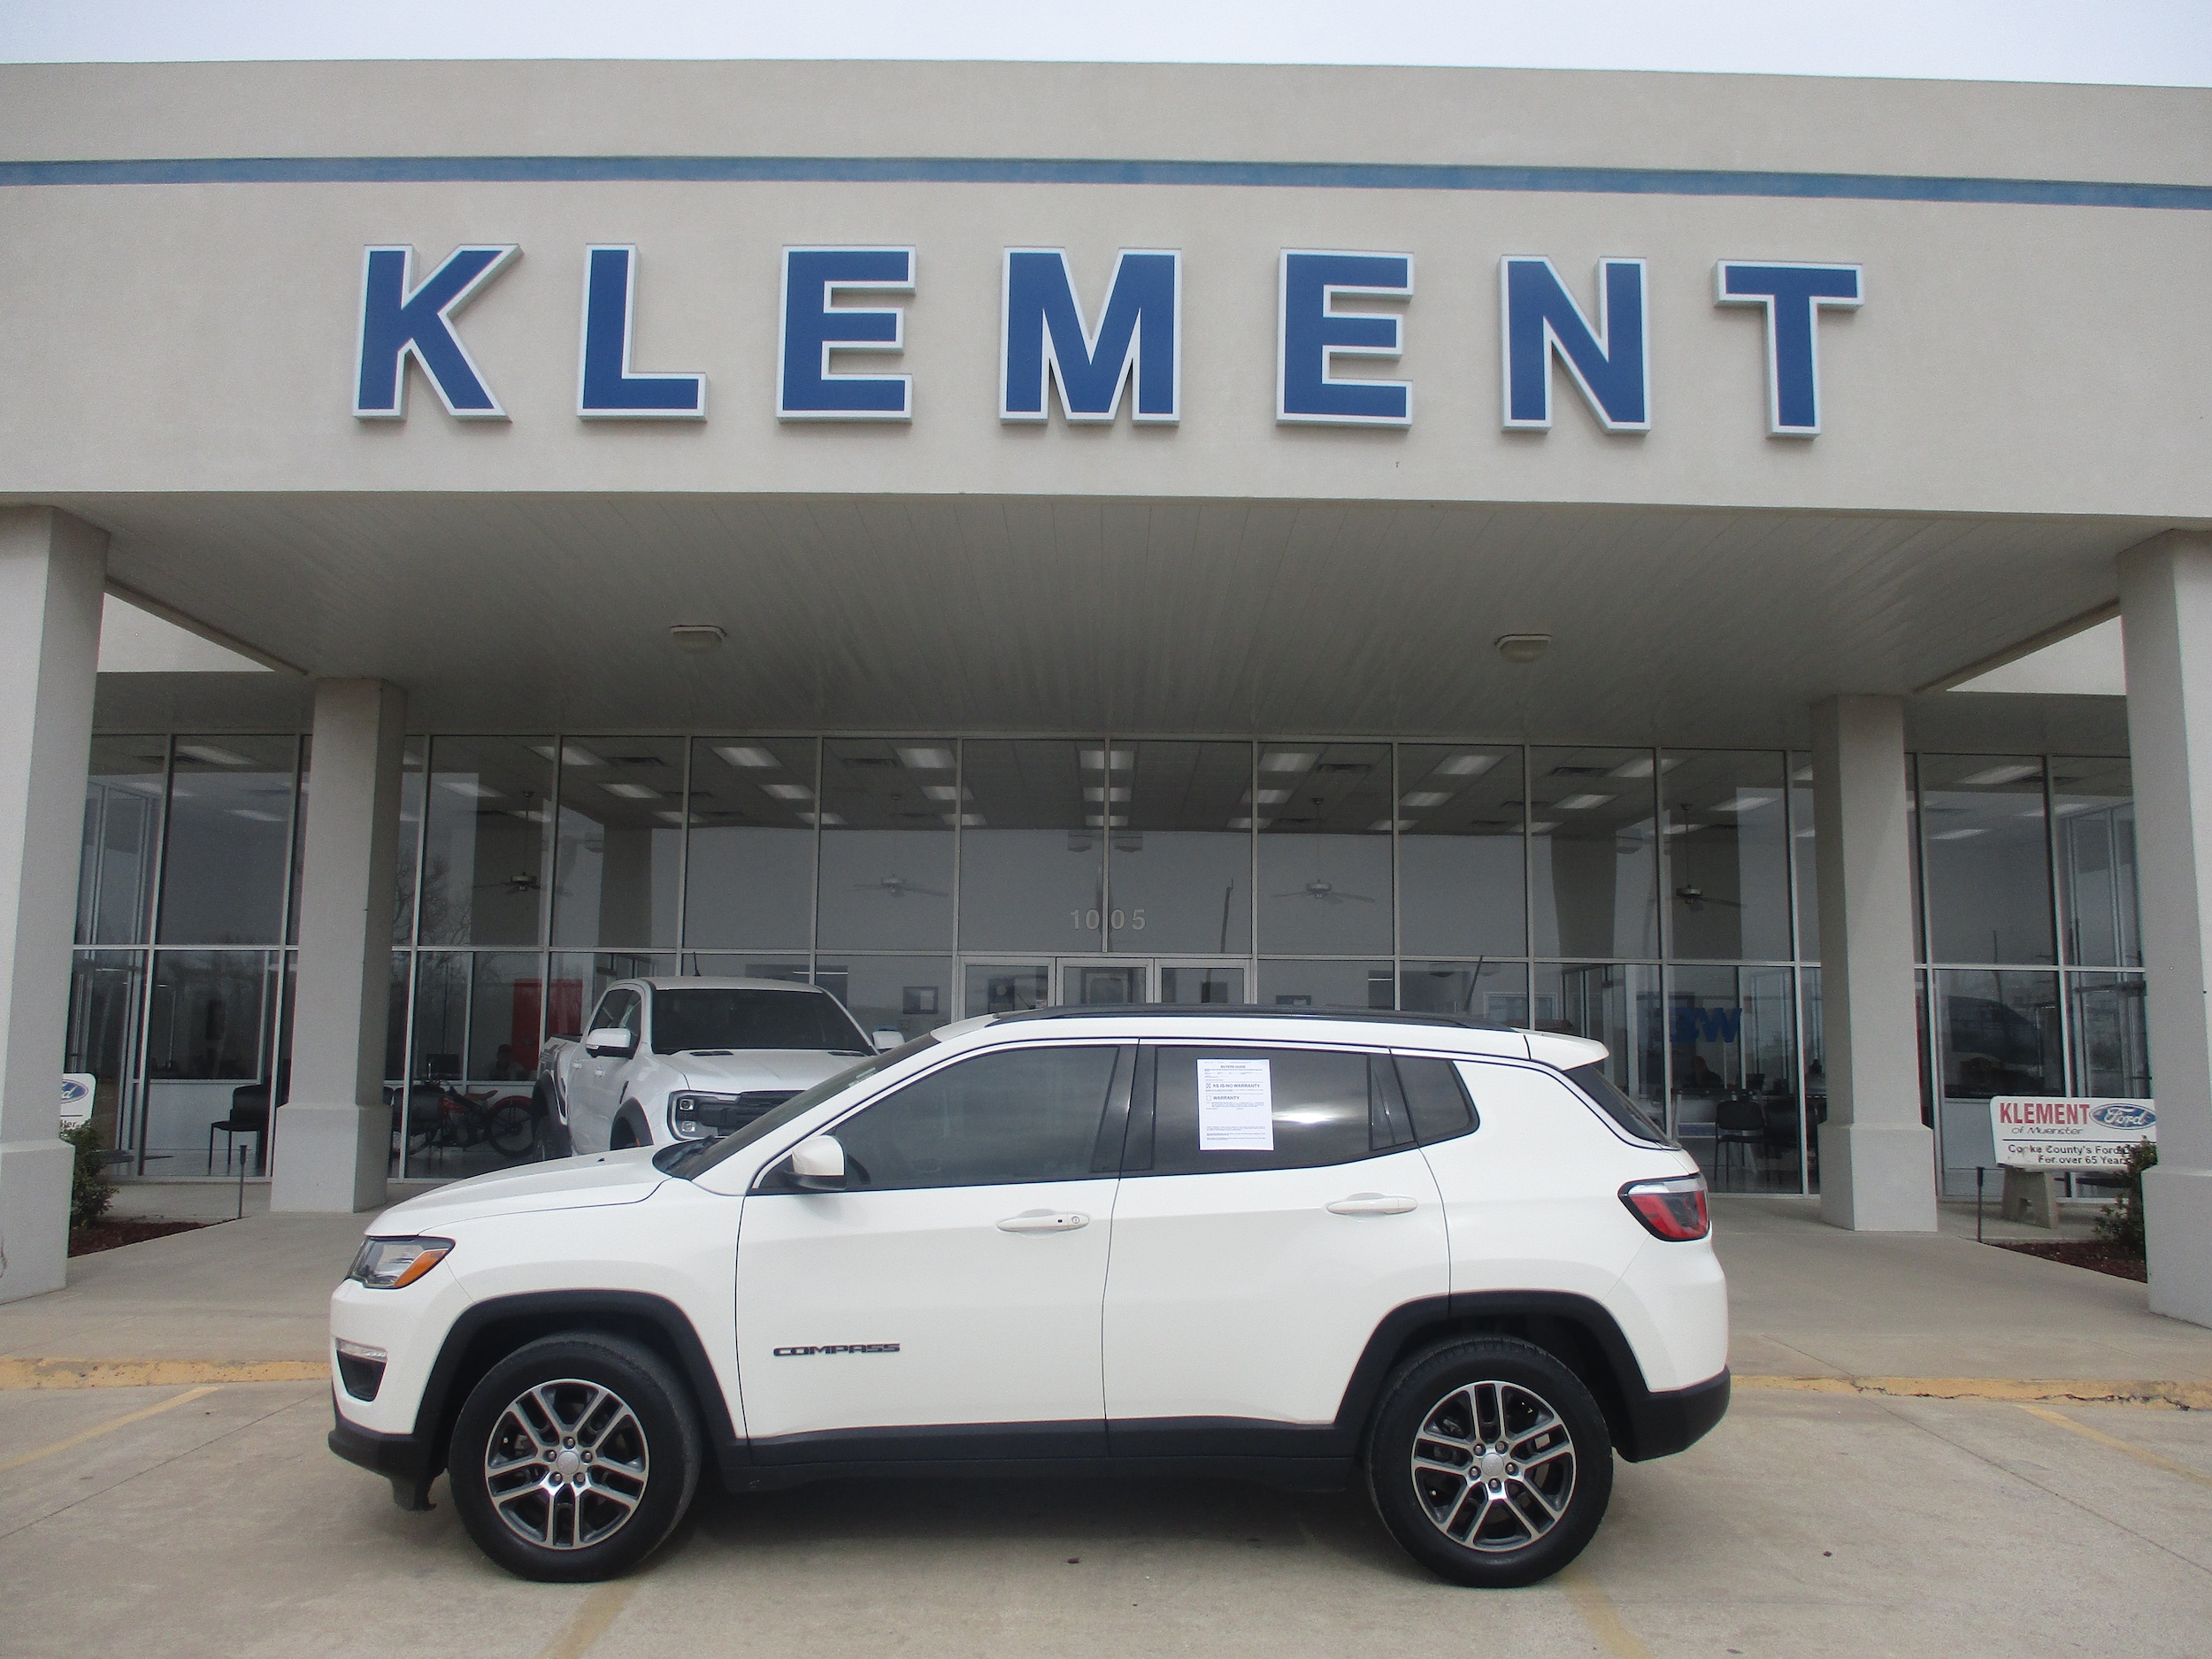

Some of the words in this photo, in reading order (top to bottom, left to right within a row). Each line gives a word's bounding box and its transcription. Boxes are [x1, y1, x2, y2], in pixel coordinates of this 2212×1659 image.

[354, 243, 1864, 438] KLEMENT
[1070, 909, 1146, 930] 1005
[1999, 1102, 2091, 1125] KLEMENT
[2103, 1107, 2150, 1125] Ford
[2011, 1125, 2024, 1134] of
[2027, 1126, 2083, 1135] Muenster
[2008, 1144, 2042, 1154] Coke
[2046, 1145, 2092, 1156] County's
[2038, 1155, 2055, 1164] For
[2085, 1156, 2097, 1164] 65
[773, 1343, 901, 1356] COMPASS
